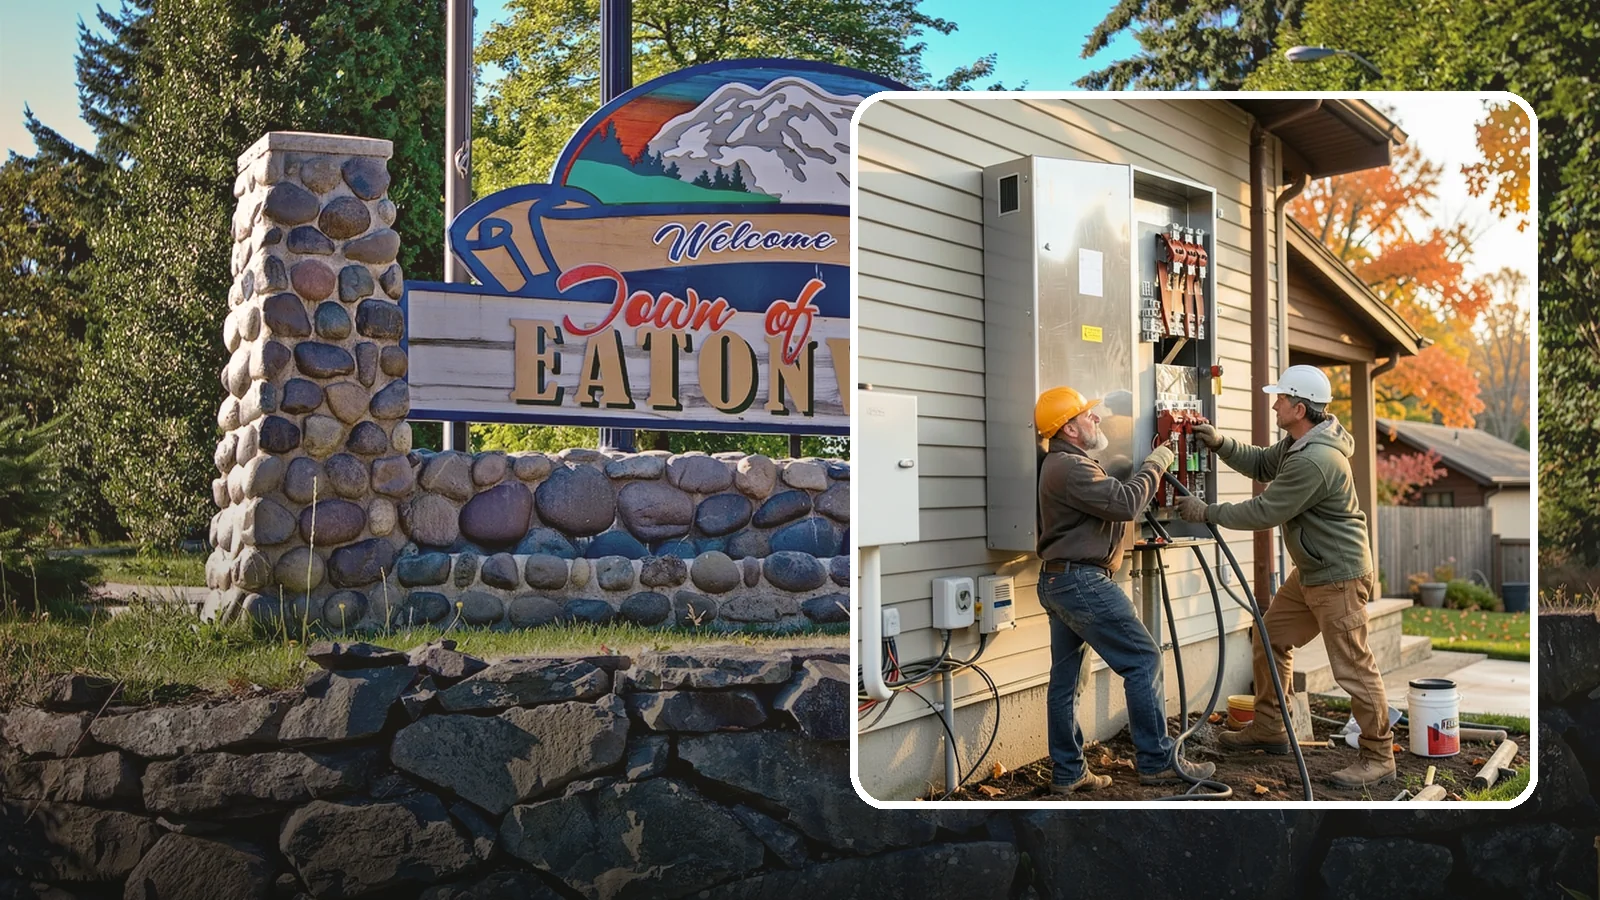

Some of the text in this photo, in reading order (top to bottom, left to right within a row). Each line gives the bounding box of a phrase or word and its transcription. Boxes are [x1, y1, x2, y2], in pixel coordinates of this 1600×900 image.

[653, 220, 837, 263] Welcome
[556, 263, 826, 365] Town of
